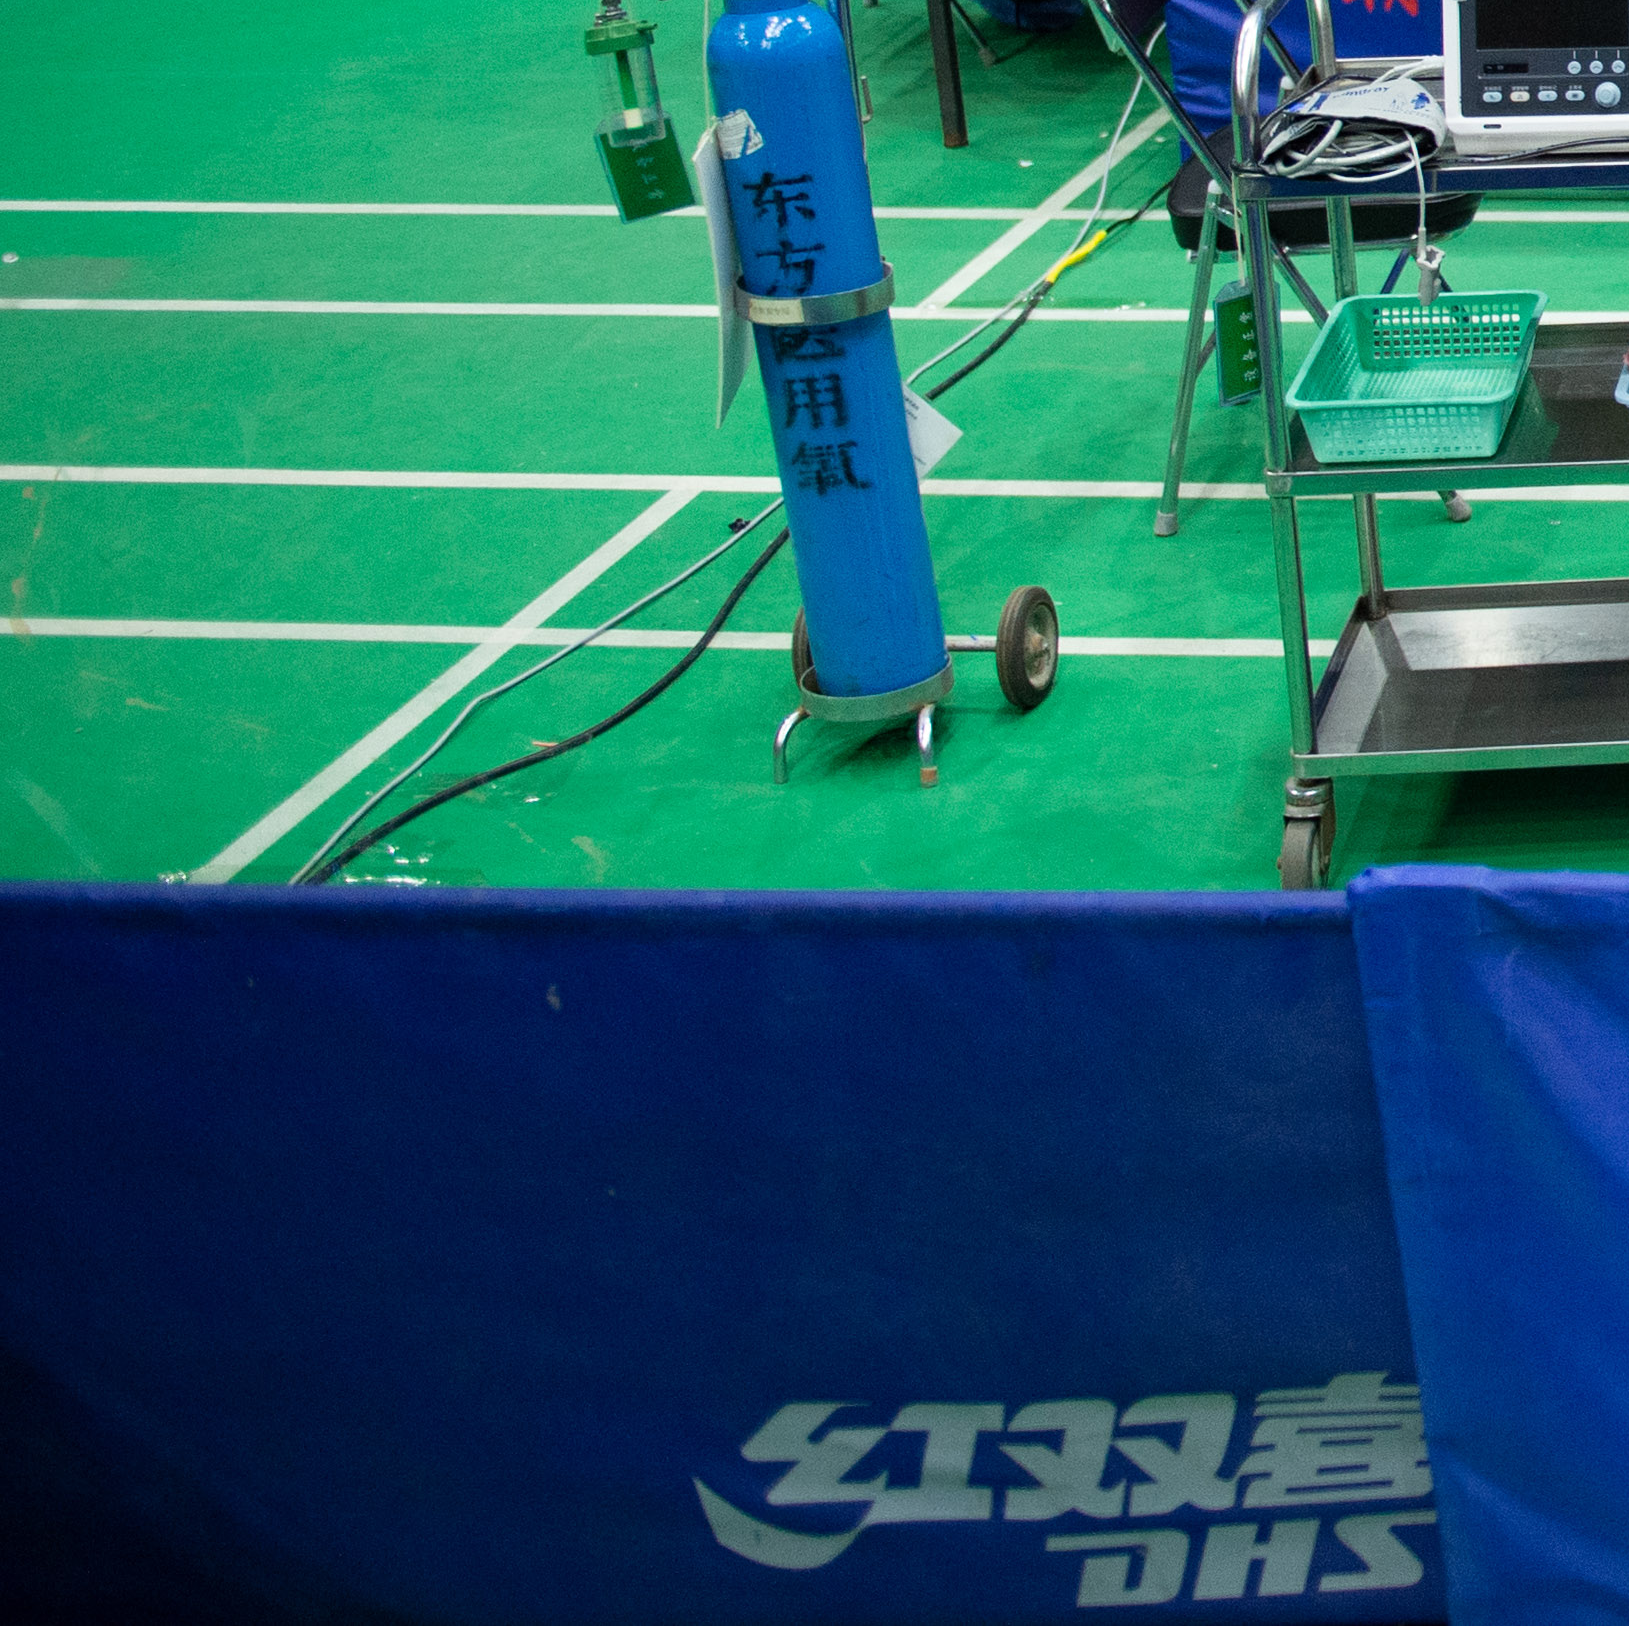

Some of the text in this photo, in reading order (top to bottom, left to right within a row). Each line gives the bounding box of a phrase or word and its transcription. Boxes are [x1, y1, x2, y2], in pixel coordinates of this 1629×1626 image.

[692, 1371, 1435, 1570] 红双喜
[1045, 1510, 1438, 1609] DHS
